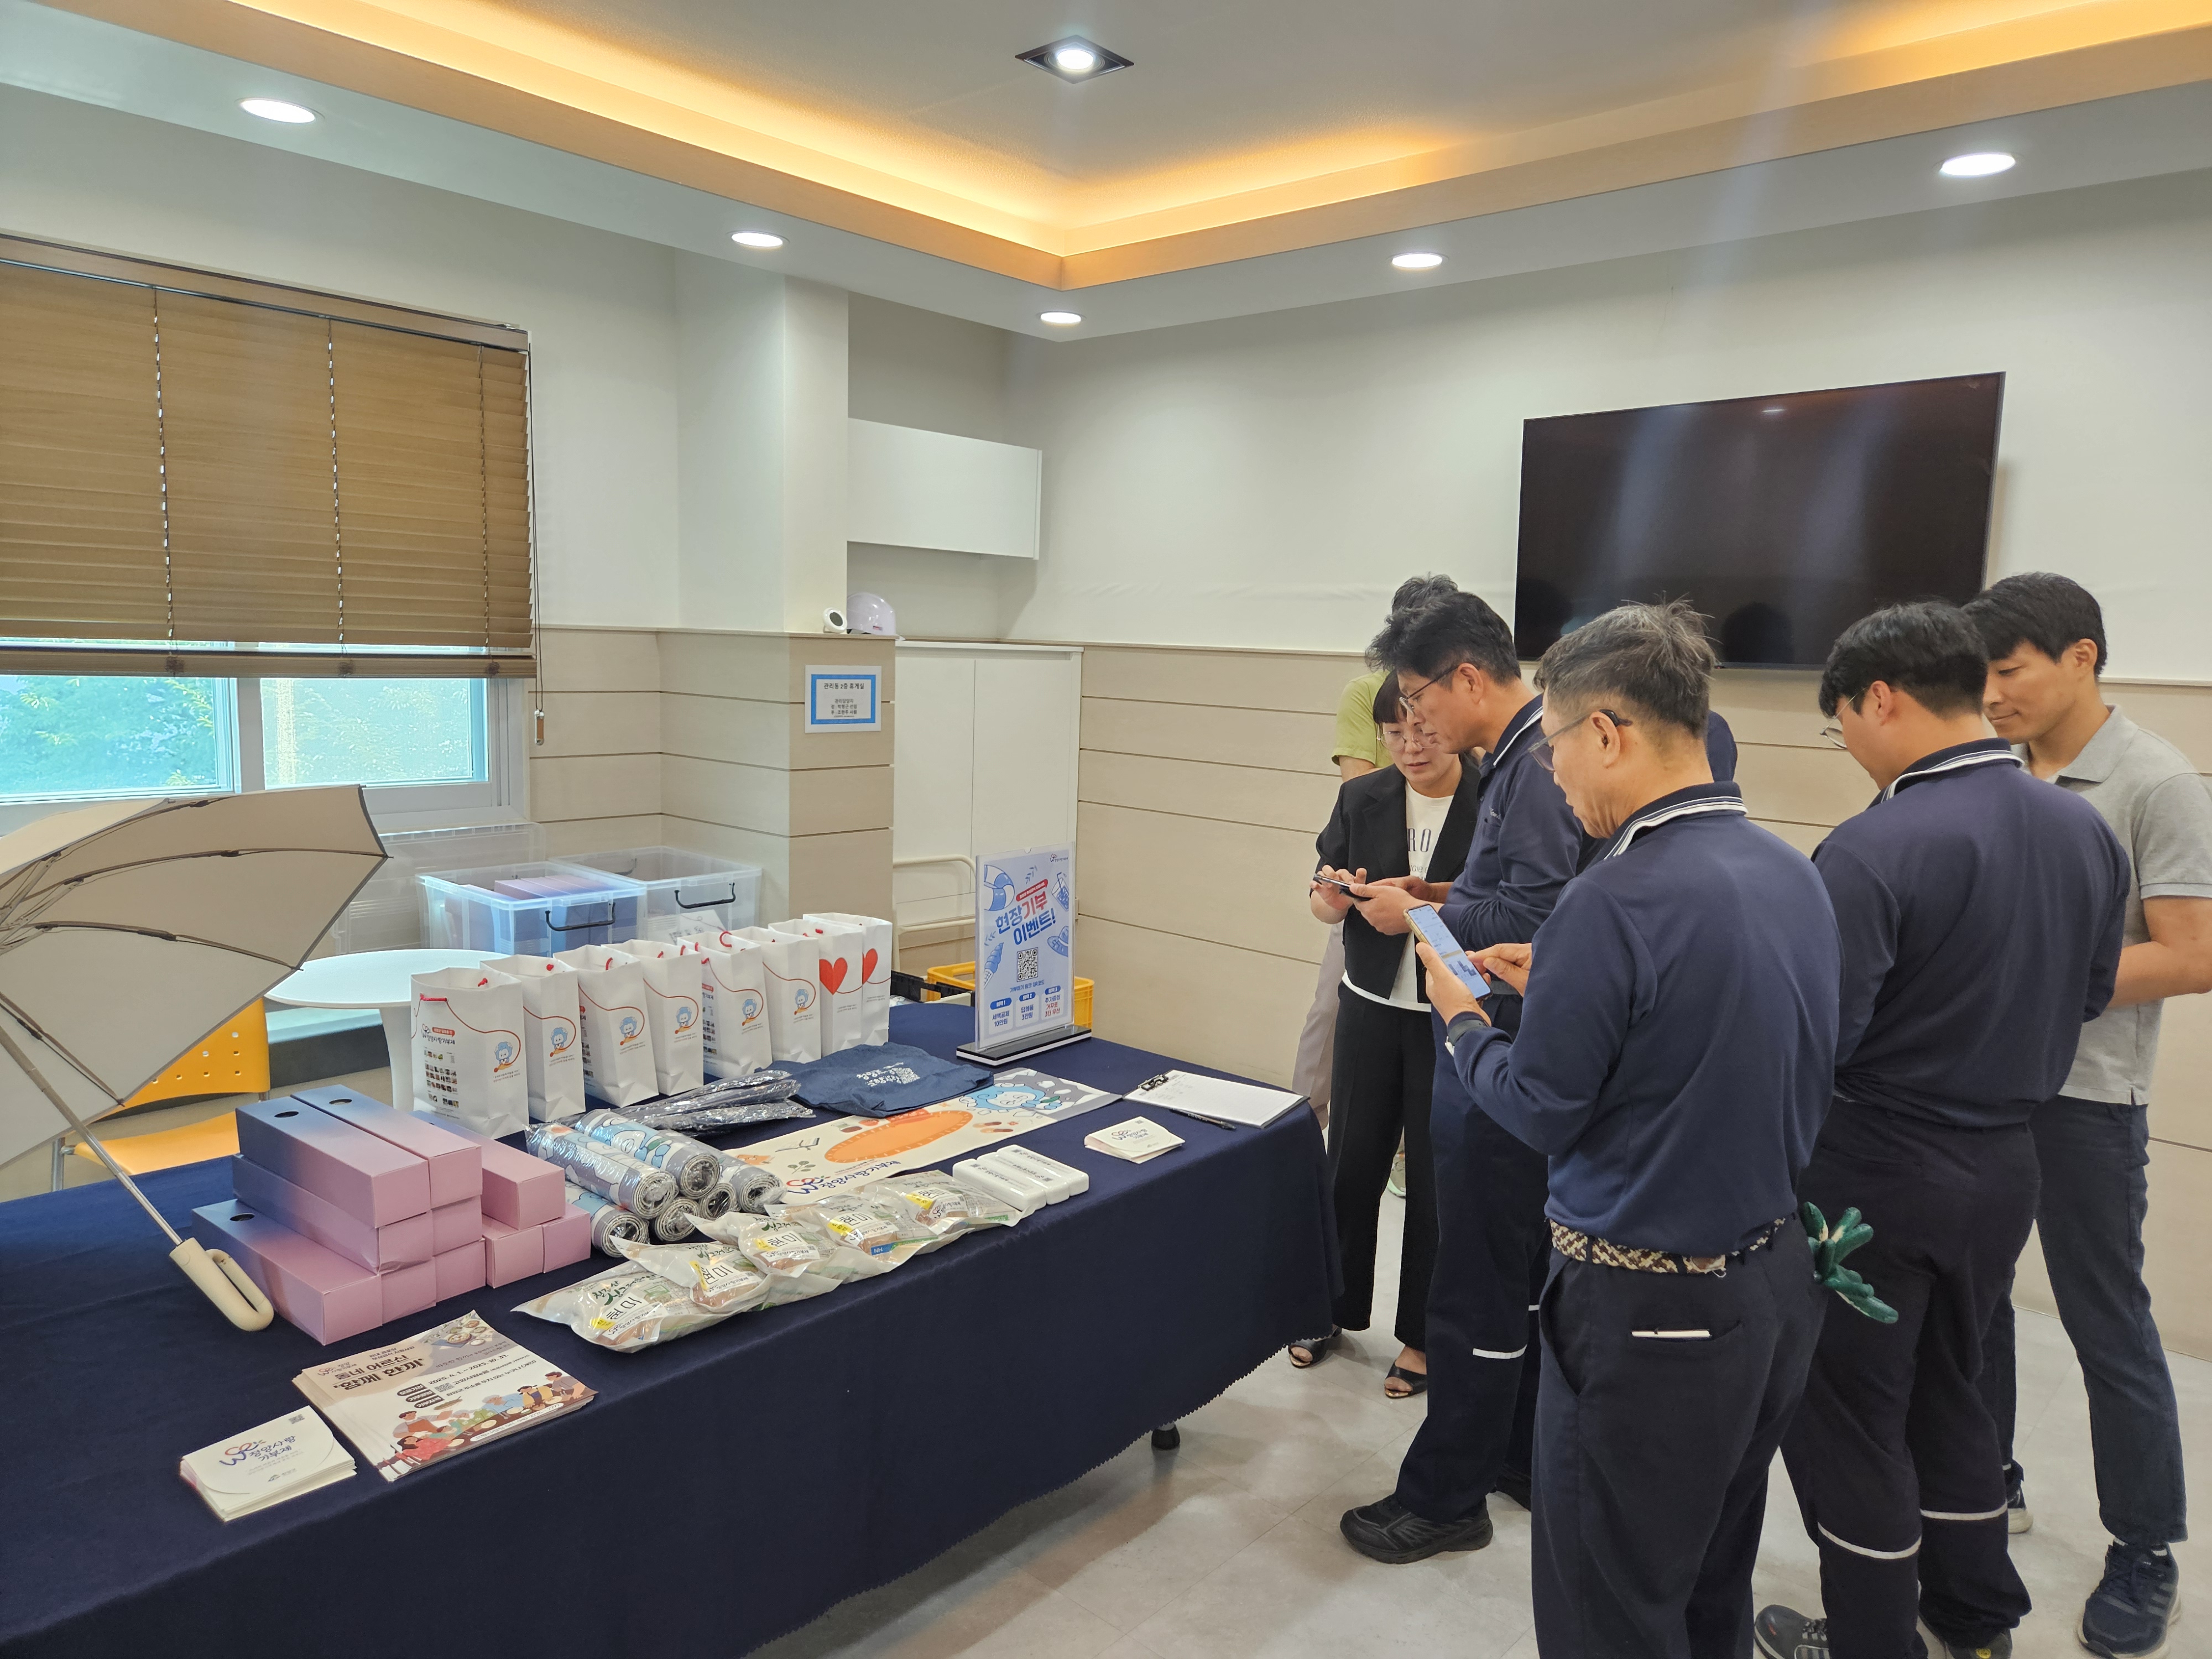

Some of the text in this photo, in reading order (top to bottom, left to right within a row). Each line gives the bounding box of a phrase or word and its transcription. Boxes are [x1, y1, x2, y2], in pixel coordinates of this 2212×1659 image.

[995, 891, 1048, 935] 현장기부
[1013, 907, 1056, 945] 이벤트!
[334, 1354, 410, 1380] 동네 어르신
[428, 1376, 450, 1385] 2025.
[468, 1361, 489, 1371] 2025.
[504, 1366, 521, 1375] 누구나
[258, 1445, 292, 1461] 기부제
